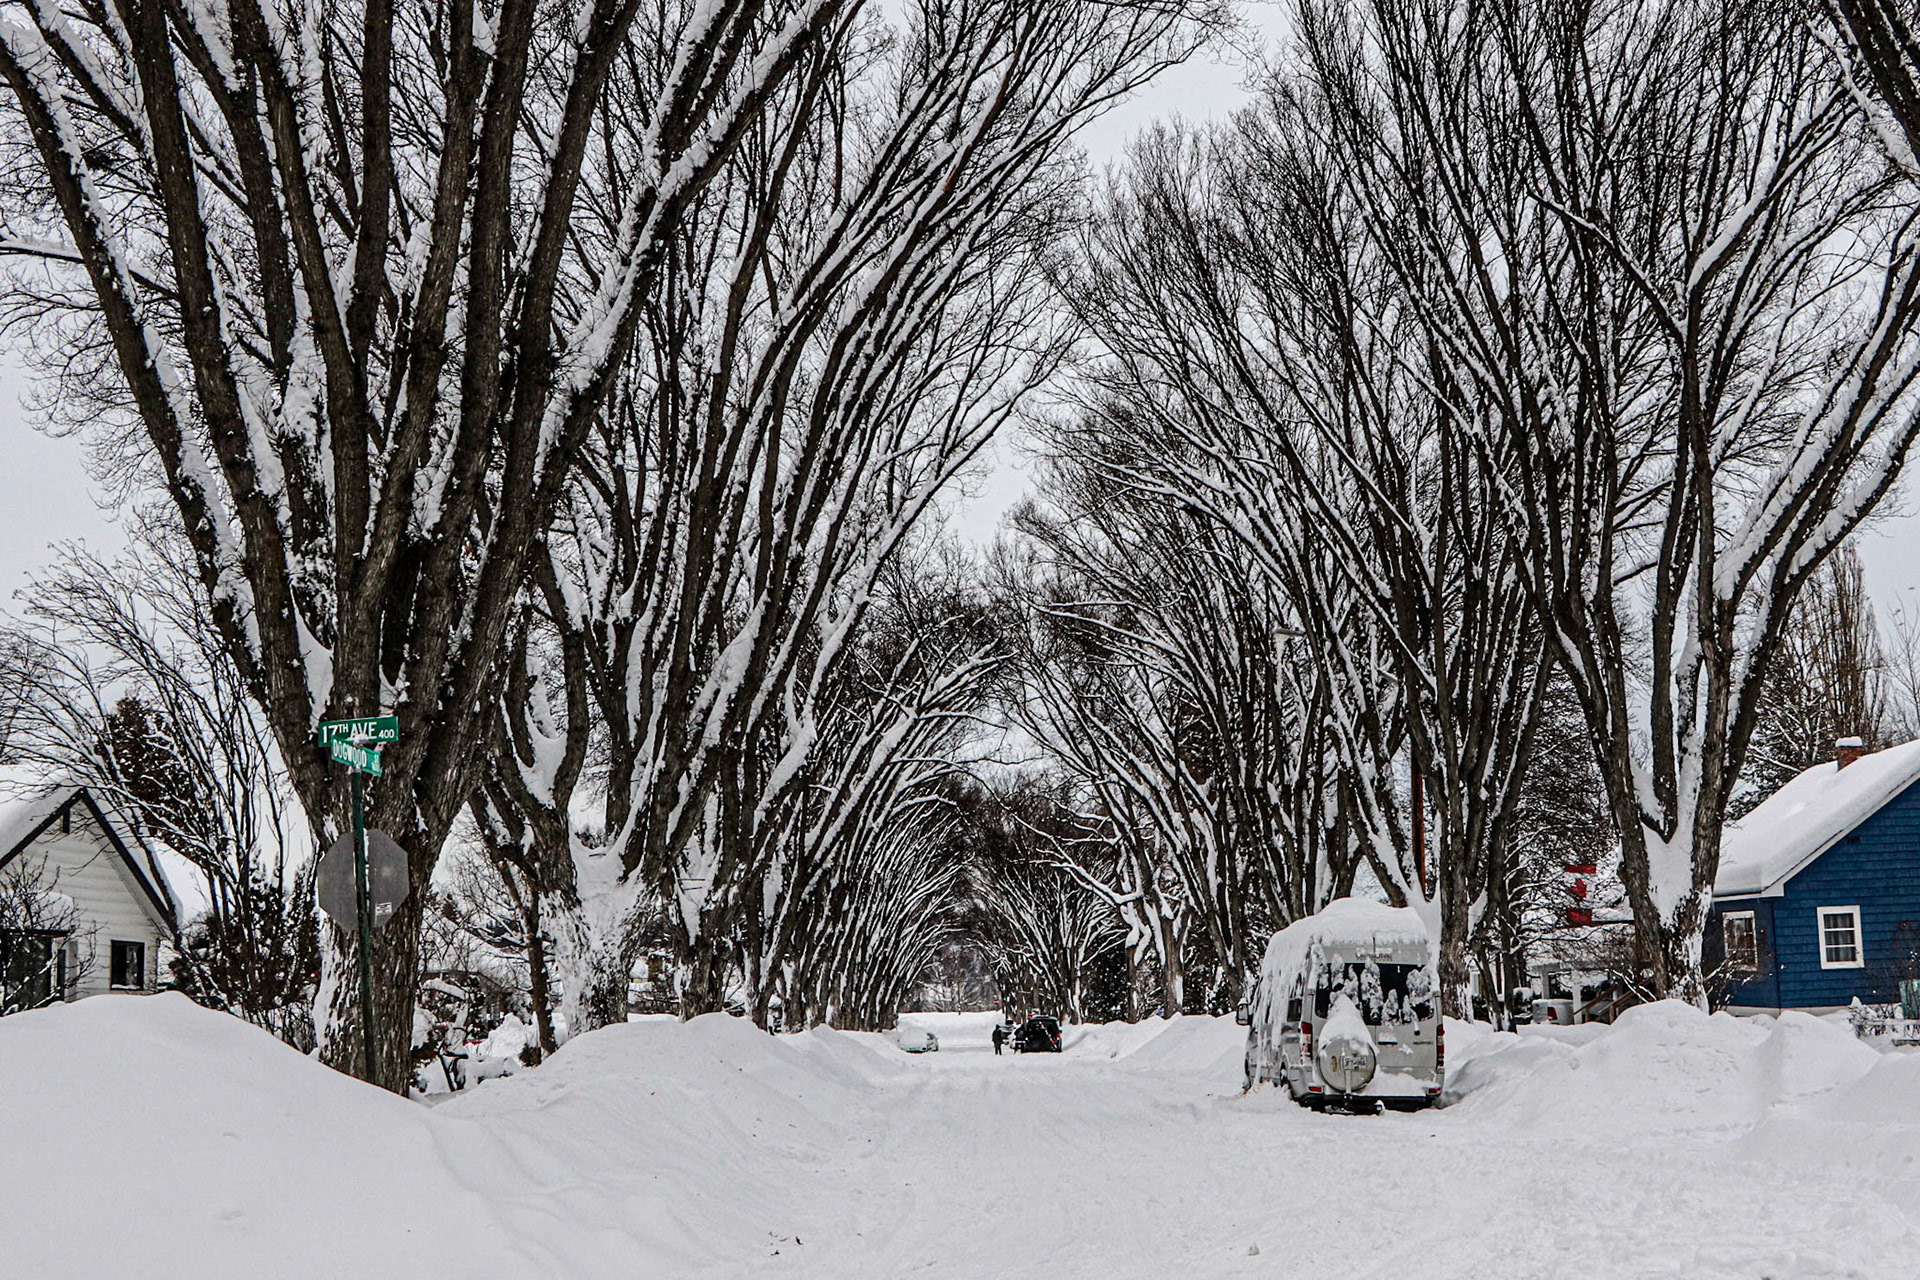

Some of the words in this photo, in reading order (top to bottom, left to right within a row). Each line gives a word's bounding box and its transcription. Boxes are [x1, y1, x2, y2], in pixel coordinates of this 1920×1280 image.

[322, 723, 349, 743] 17TH
[350, 721, 377, 739] AVE
[378, 729, 395, 739] 400
[333, 738, 367, 768] DOGWOOD
